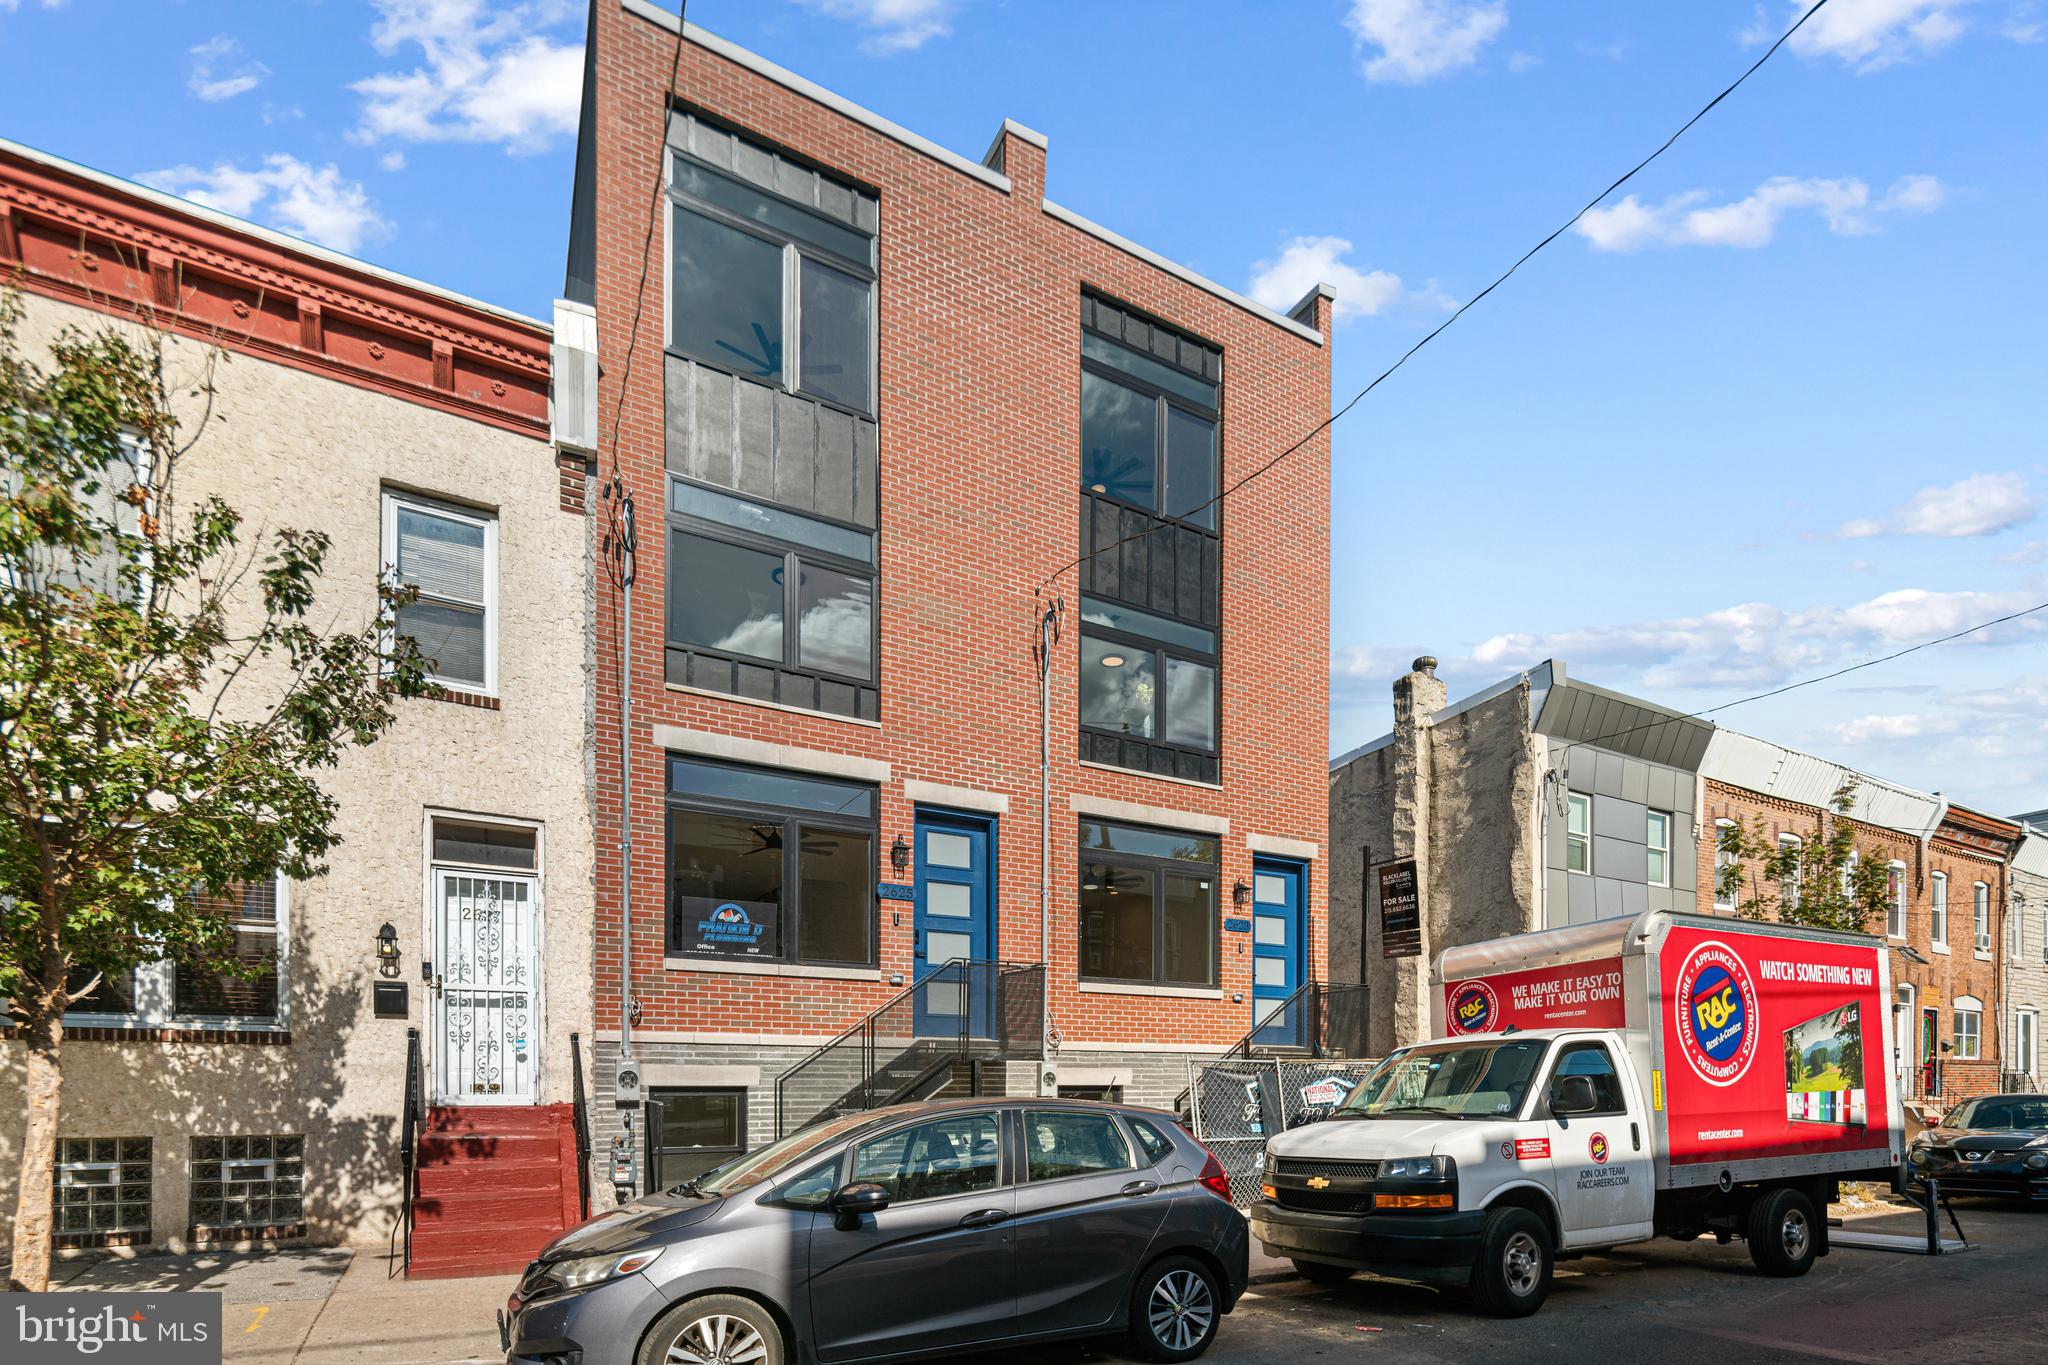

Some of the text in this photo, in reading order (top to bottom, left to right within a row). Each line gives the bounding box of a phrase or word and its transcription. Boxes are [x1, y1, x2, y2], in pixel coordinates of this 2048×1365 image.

[882, 886, 913, 898] 2625
[1384, 894, 1416, 906] FOR SALE
[698, 921, 750, 934] FRANKIE
[1694, 950, 1738, 972] APPLIANCES
[1760, 960, 1872, 986] WATCH SOMETHING NEW
[1512, 972, 1622, 998] WE MAKE IT EASY TO
[1460, 998, 1484, 1018] RAC
[1514, 986, 1620, 1010] MAKE IT YOUR OWN
[1544, 1009, 1586, 1020] rentacenter.com
[1680, 975, 1693, 1046] FURNITURE
[1696, 987, 1736, 1031] RAC
[1741, 980, 1754, 1056] ELECTRONICS
[1696, 1055, 1738, 1078] COMPUTERS
[1306, 1085, 1336, 1094] NATIONAL
[1698, 1129, 1744, 1140] rentacenter.com
[1580, 1166, 1626, 1180] JOIN OUR TEAM
[1577, 1177, 1630, 1190] RACCAREERS.COM
